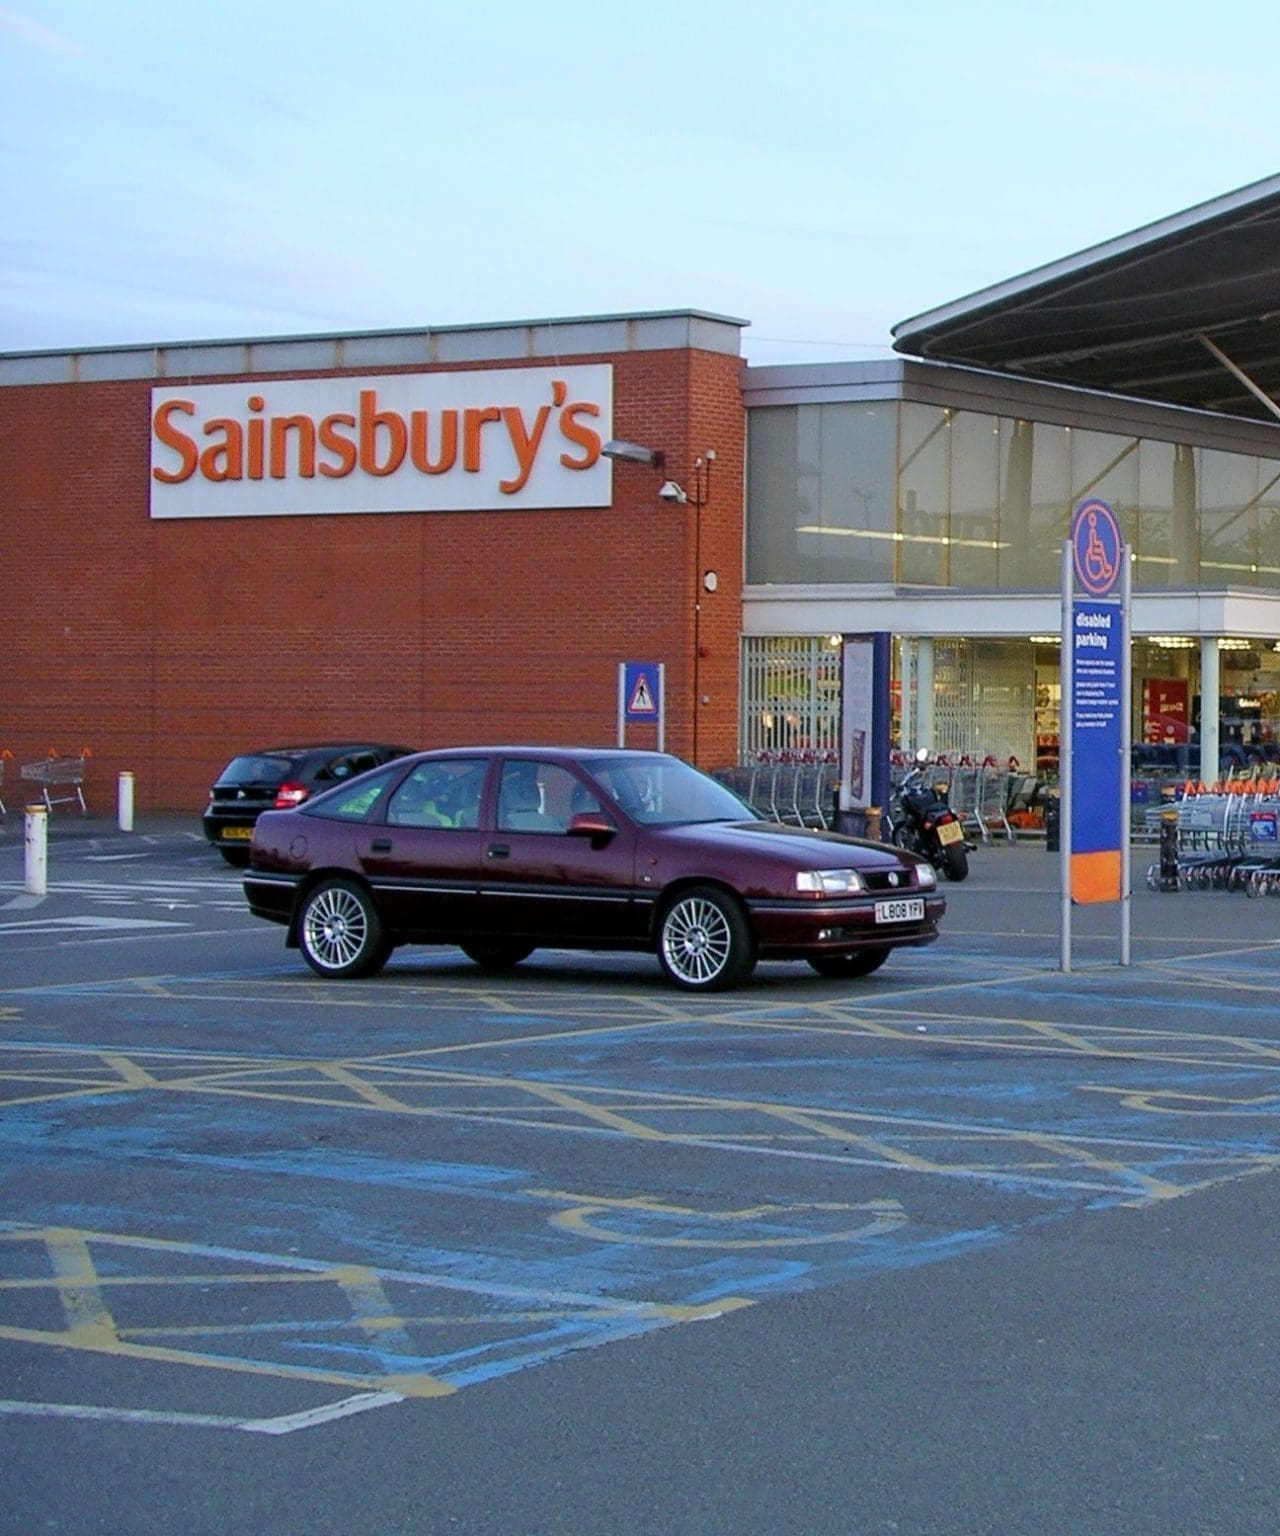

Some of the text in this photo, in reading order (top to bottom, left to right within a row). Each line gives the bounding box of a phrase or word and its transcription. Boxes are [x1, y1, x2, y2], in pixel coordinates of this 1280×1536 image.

[152, 381, 602, 494] Sainsbury's
[1076, 612, 1111, 629] disabled
[1076, 632, 1107, 650] parking
